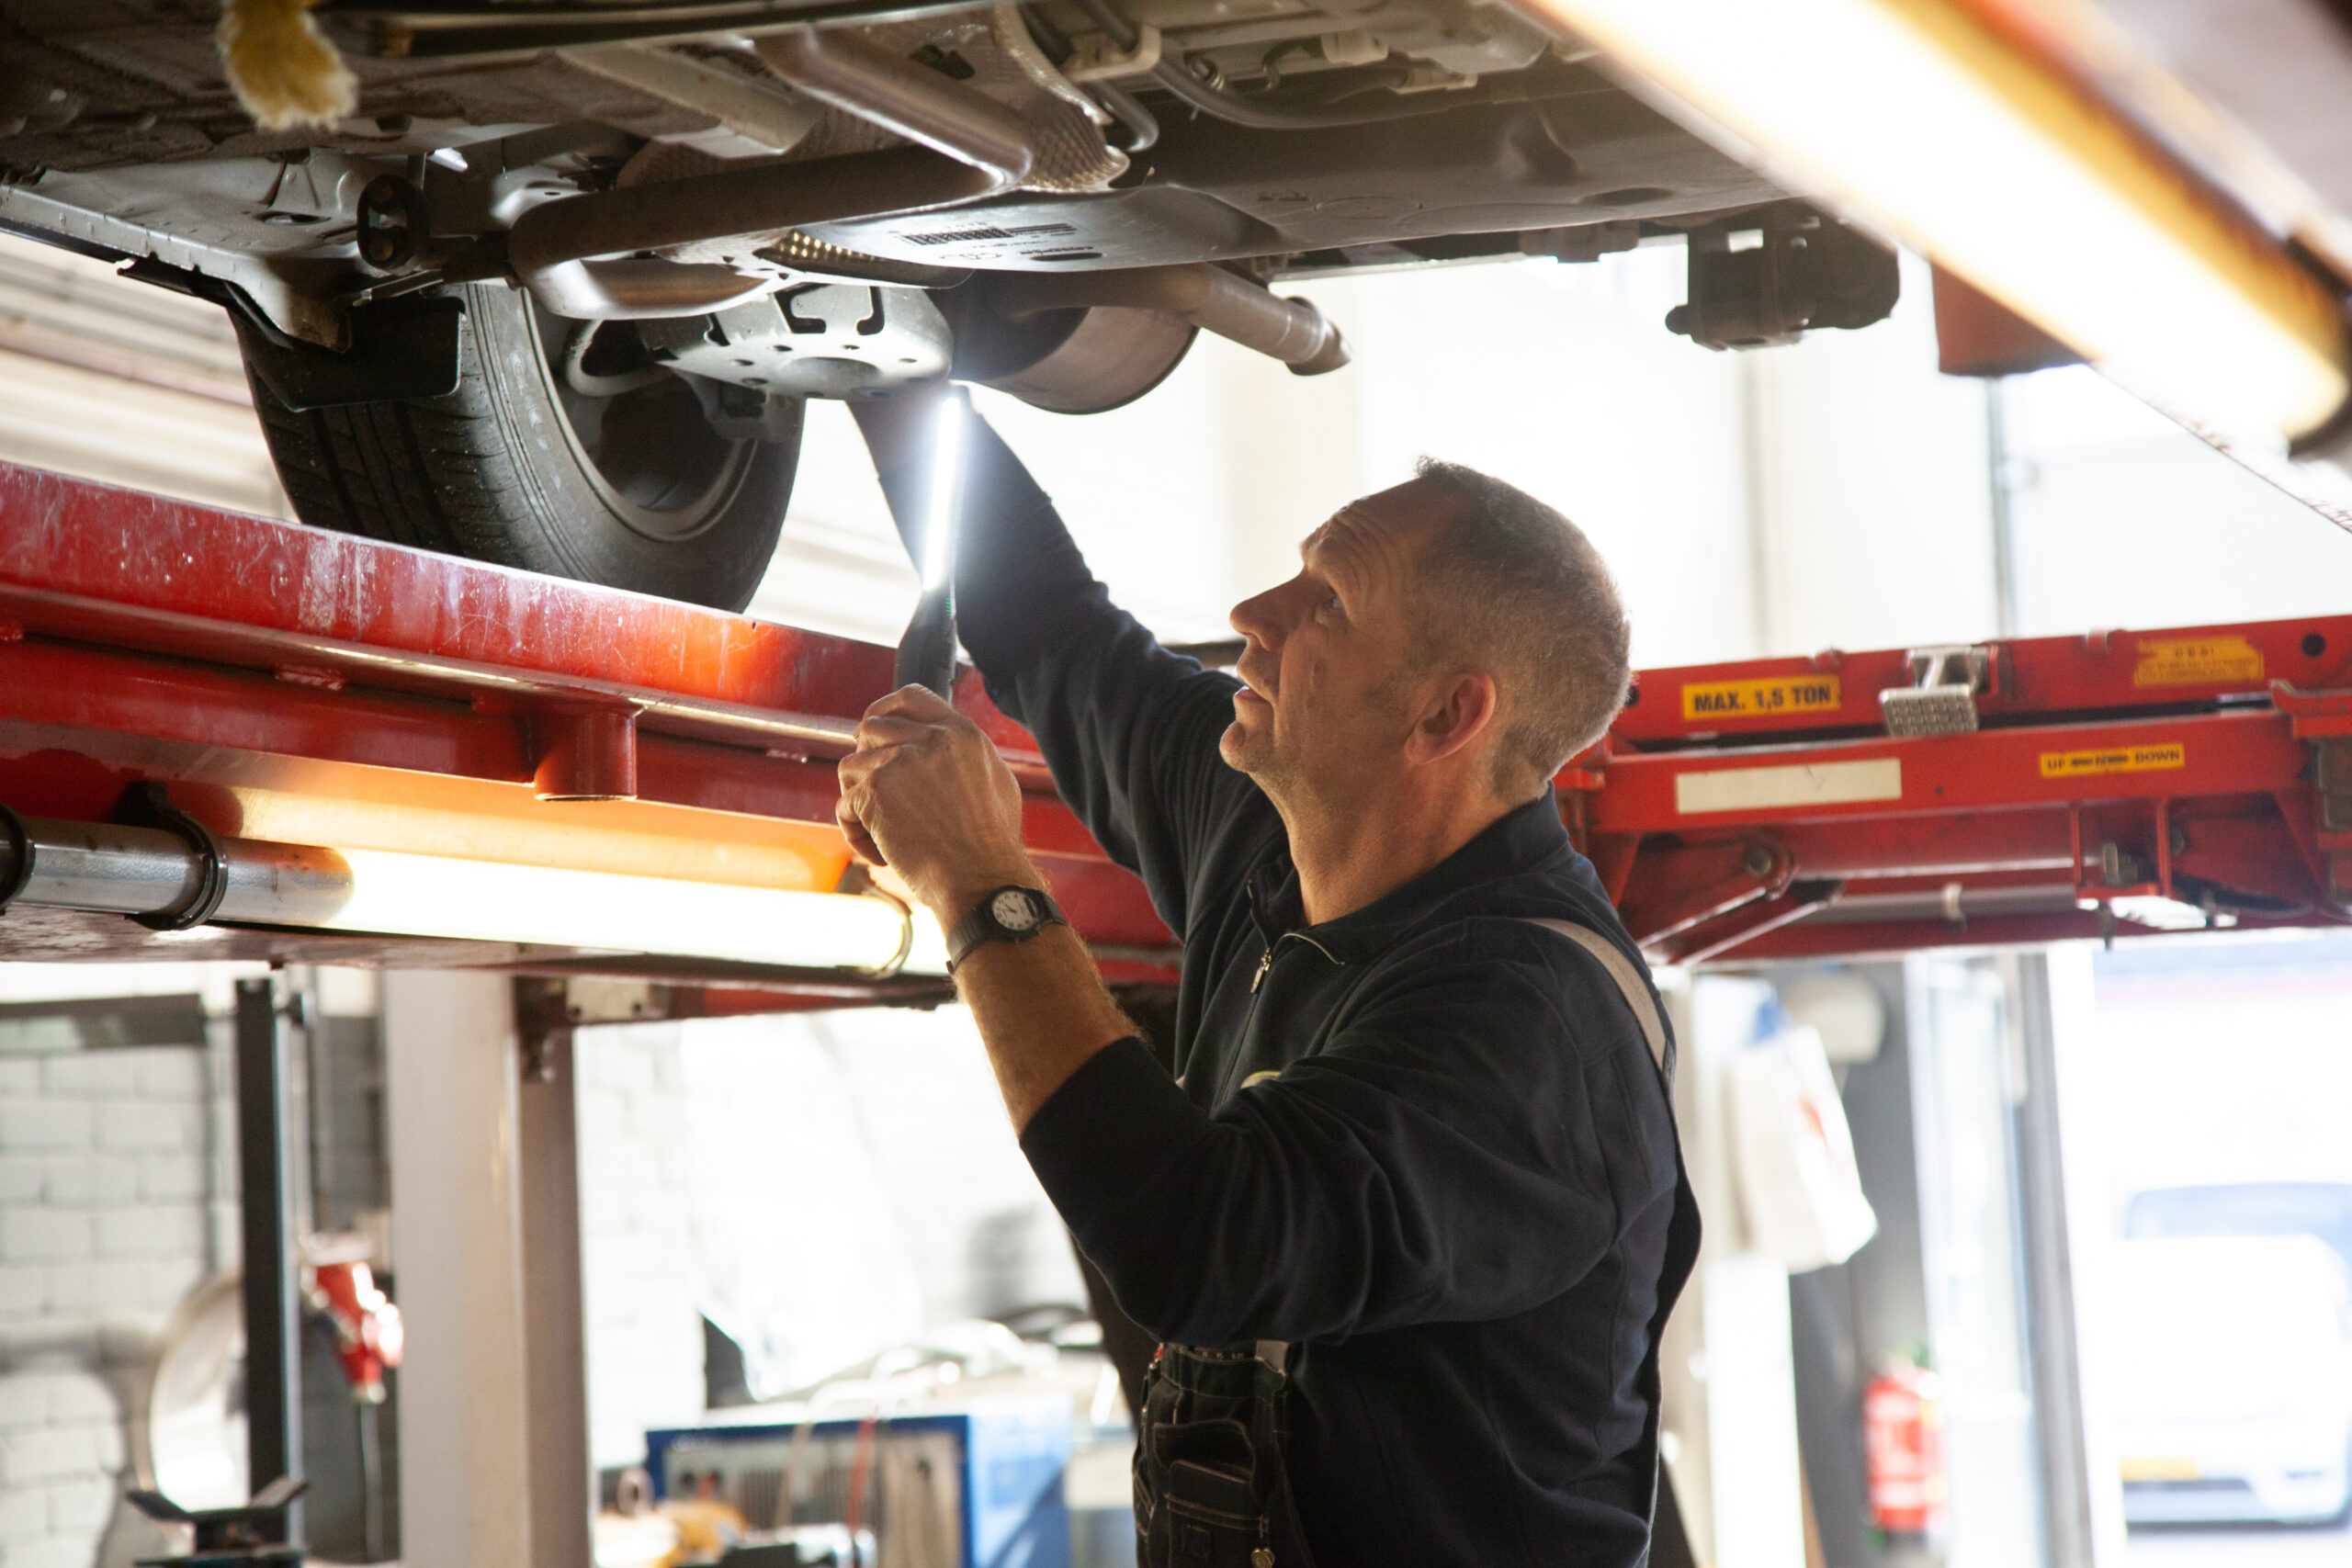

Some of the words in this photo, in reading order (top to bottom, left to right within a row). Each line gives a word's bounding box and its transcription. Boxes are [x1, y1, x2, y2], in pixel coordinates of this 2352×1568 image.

[1694, 691, 1746, 713] MAX.
[1755, 688, 1784, 713] 1,5
[1792, 684, 1831, 705] TON
[2135, 750, 2179, 763] DOWN
